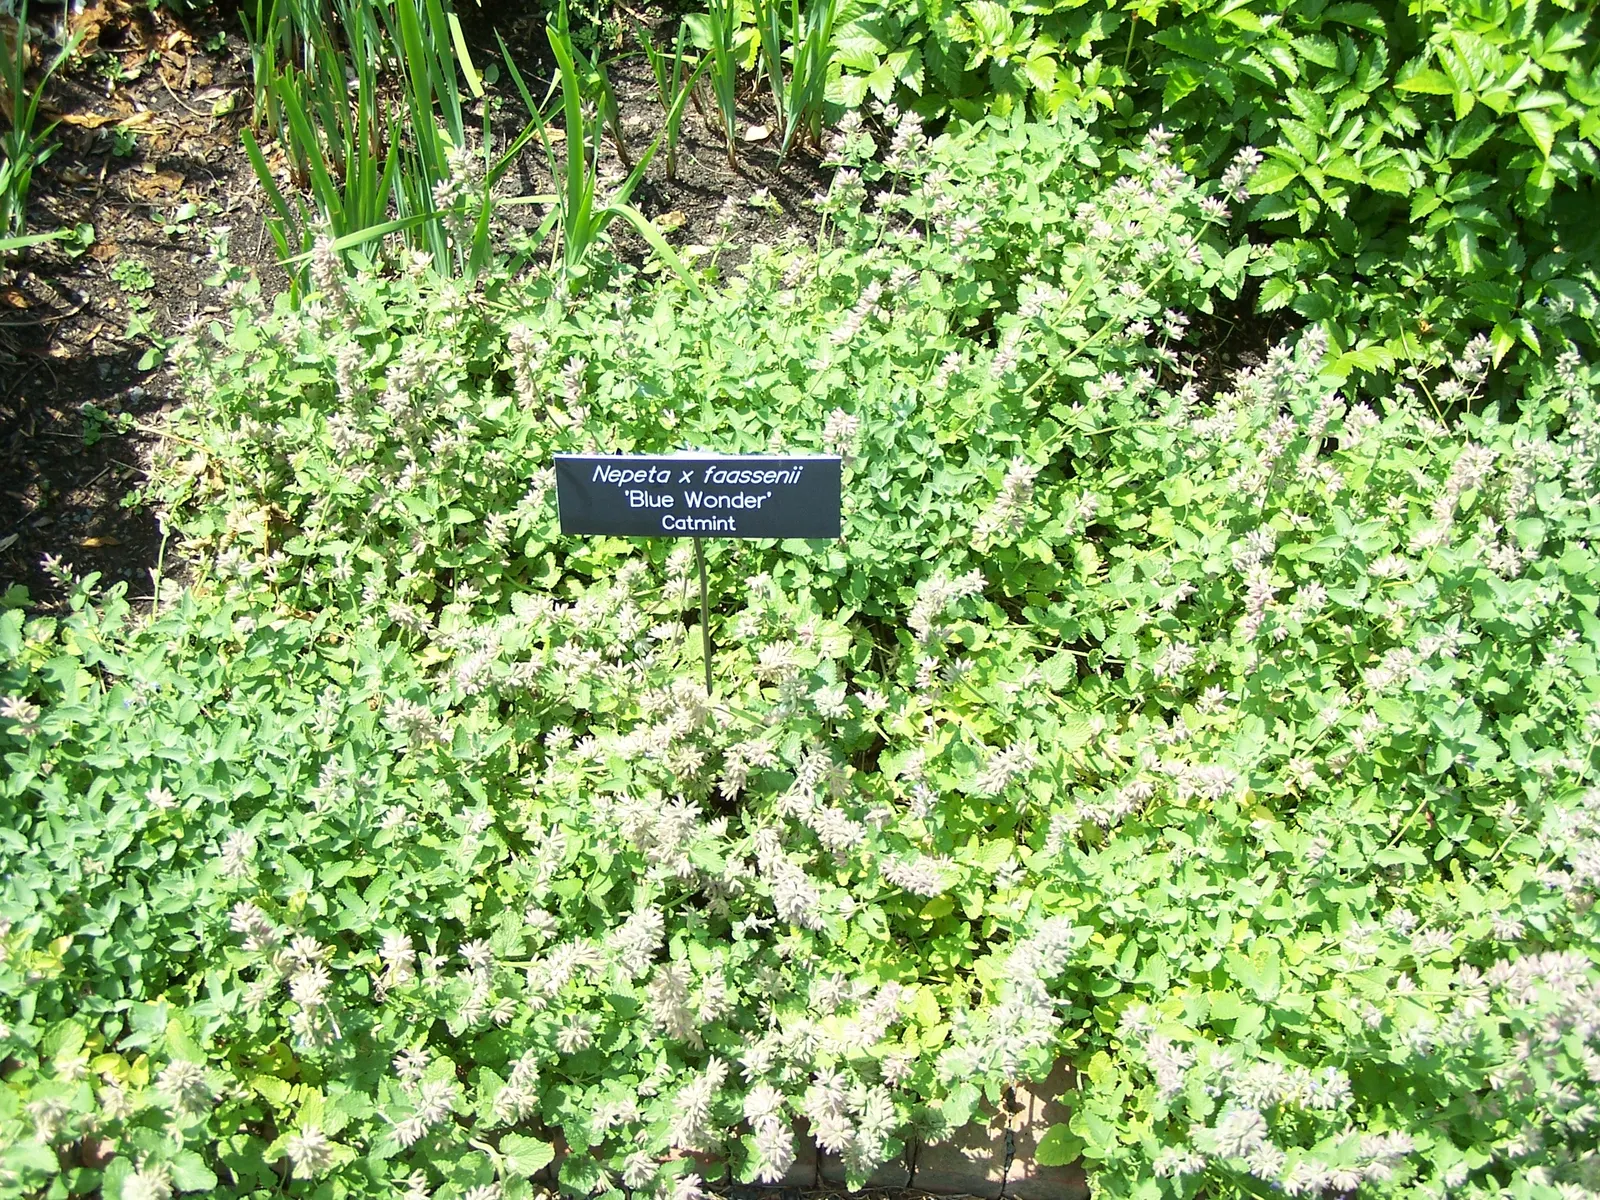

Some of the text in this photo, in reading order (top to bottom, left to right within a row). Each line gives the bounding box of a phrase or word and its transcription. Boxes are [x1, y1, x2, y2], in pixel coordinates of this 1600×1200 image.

[592, 465, 803, 487] Nepeta x faassenii
[661, 515, 736, 531] Catmint
